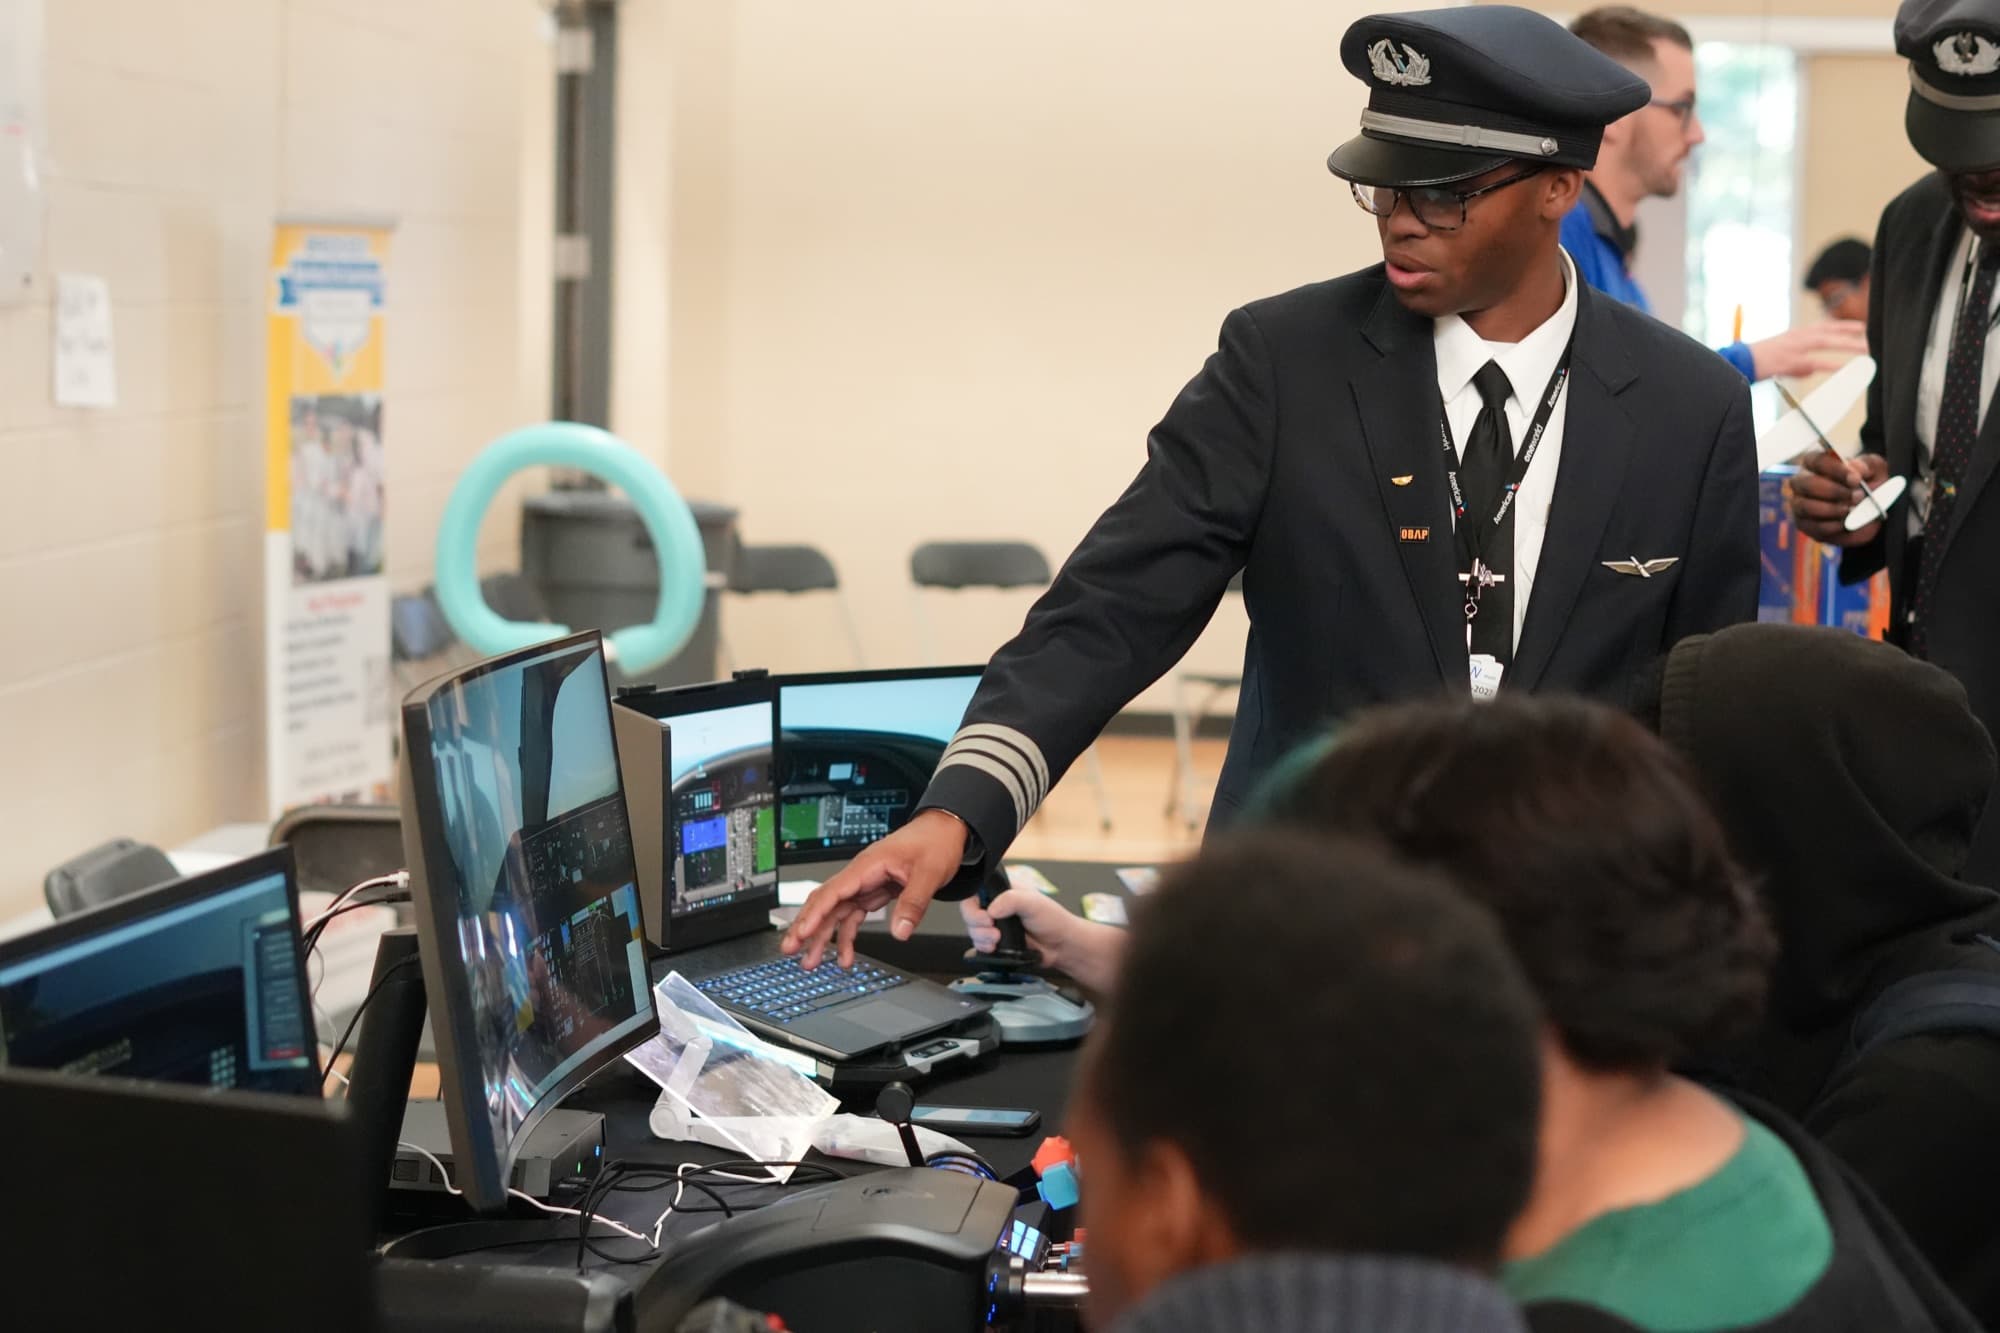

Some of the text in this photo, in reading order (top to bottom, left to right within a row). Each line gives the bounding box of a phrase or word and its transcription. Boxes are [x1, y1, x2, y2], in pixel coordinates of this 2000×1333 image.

[1548, 375, 1565, 408] American
[1524, 423, 1544, 463] oneworld
[1448, 471, 1463, 506] American
[1493, 491, 1514, 525] American
